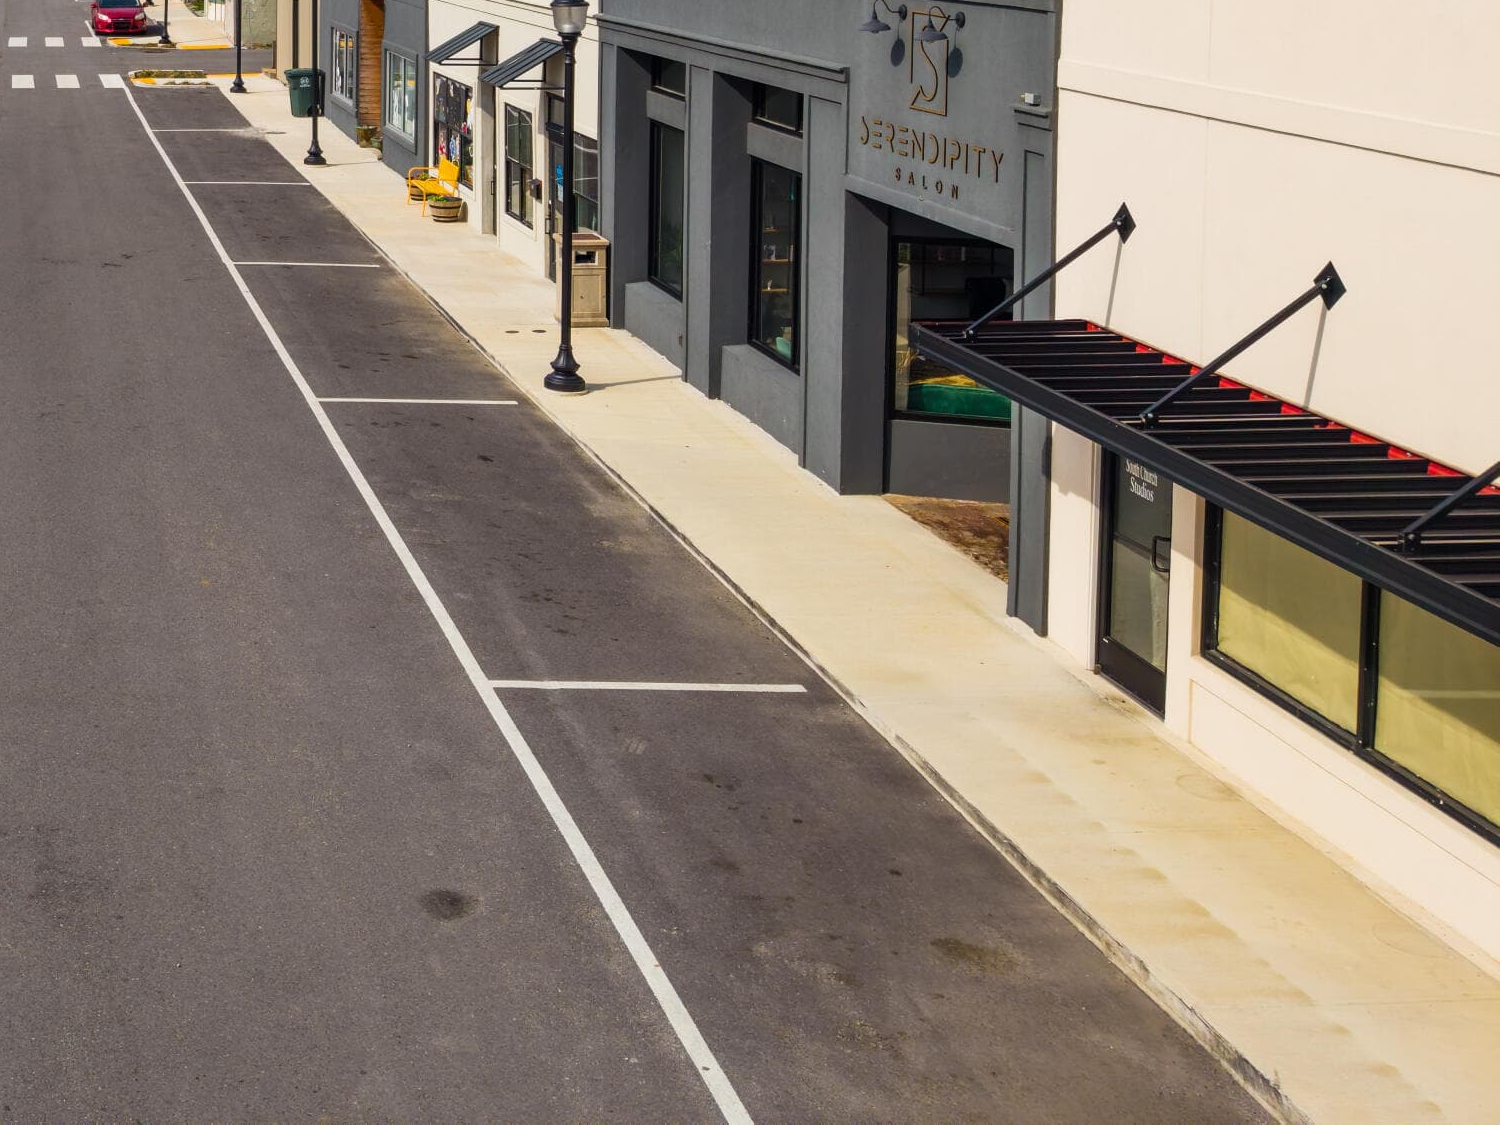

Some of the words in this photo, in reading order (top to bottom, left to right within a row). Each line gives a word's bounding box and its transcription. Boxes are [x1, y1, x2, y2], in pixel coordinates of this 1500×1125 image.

[861, 116, 1004, 183] SERENDIPITY
[895, 167, 959, 200] SALON
[1130, 476, 1155, 503] Studios
